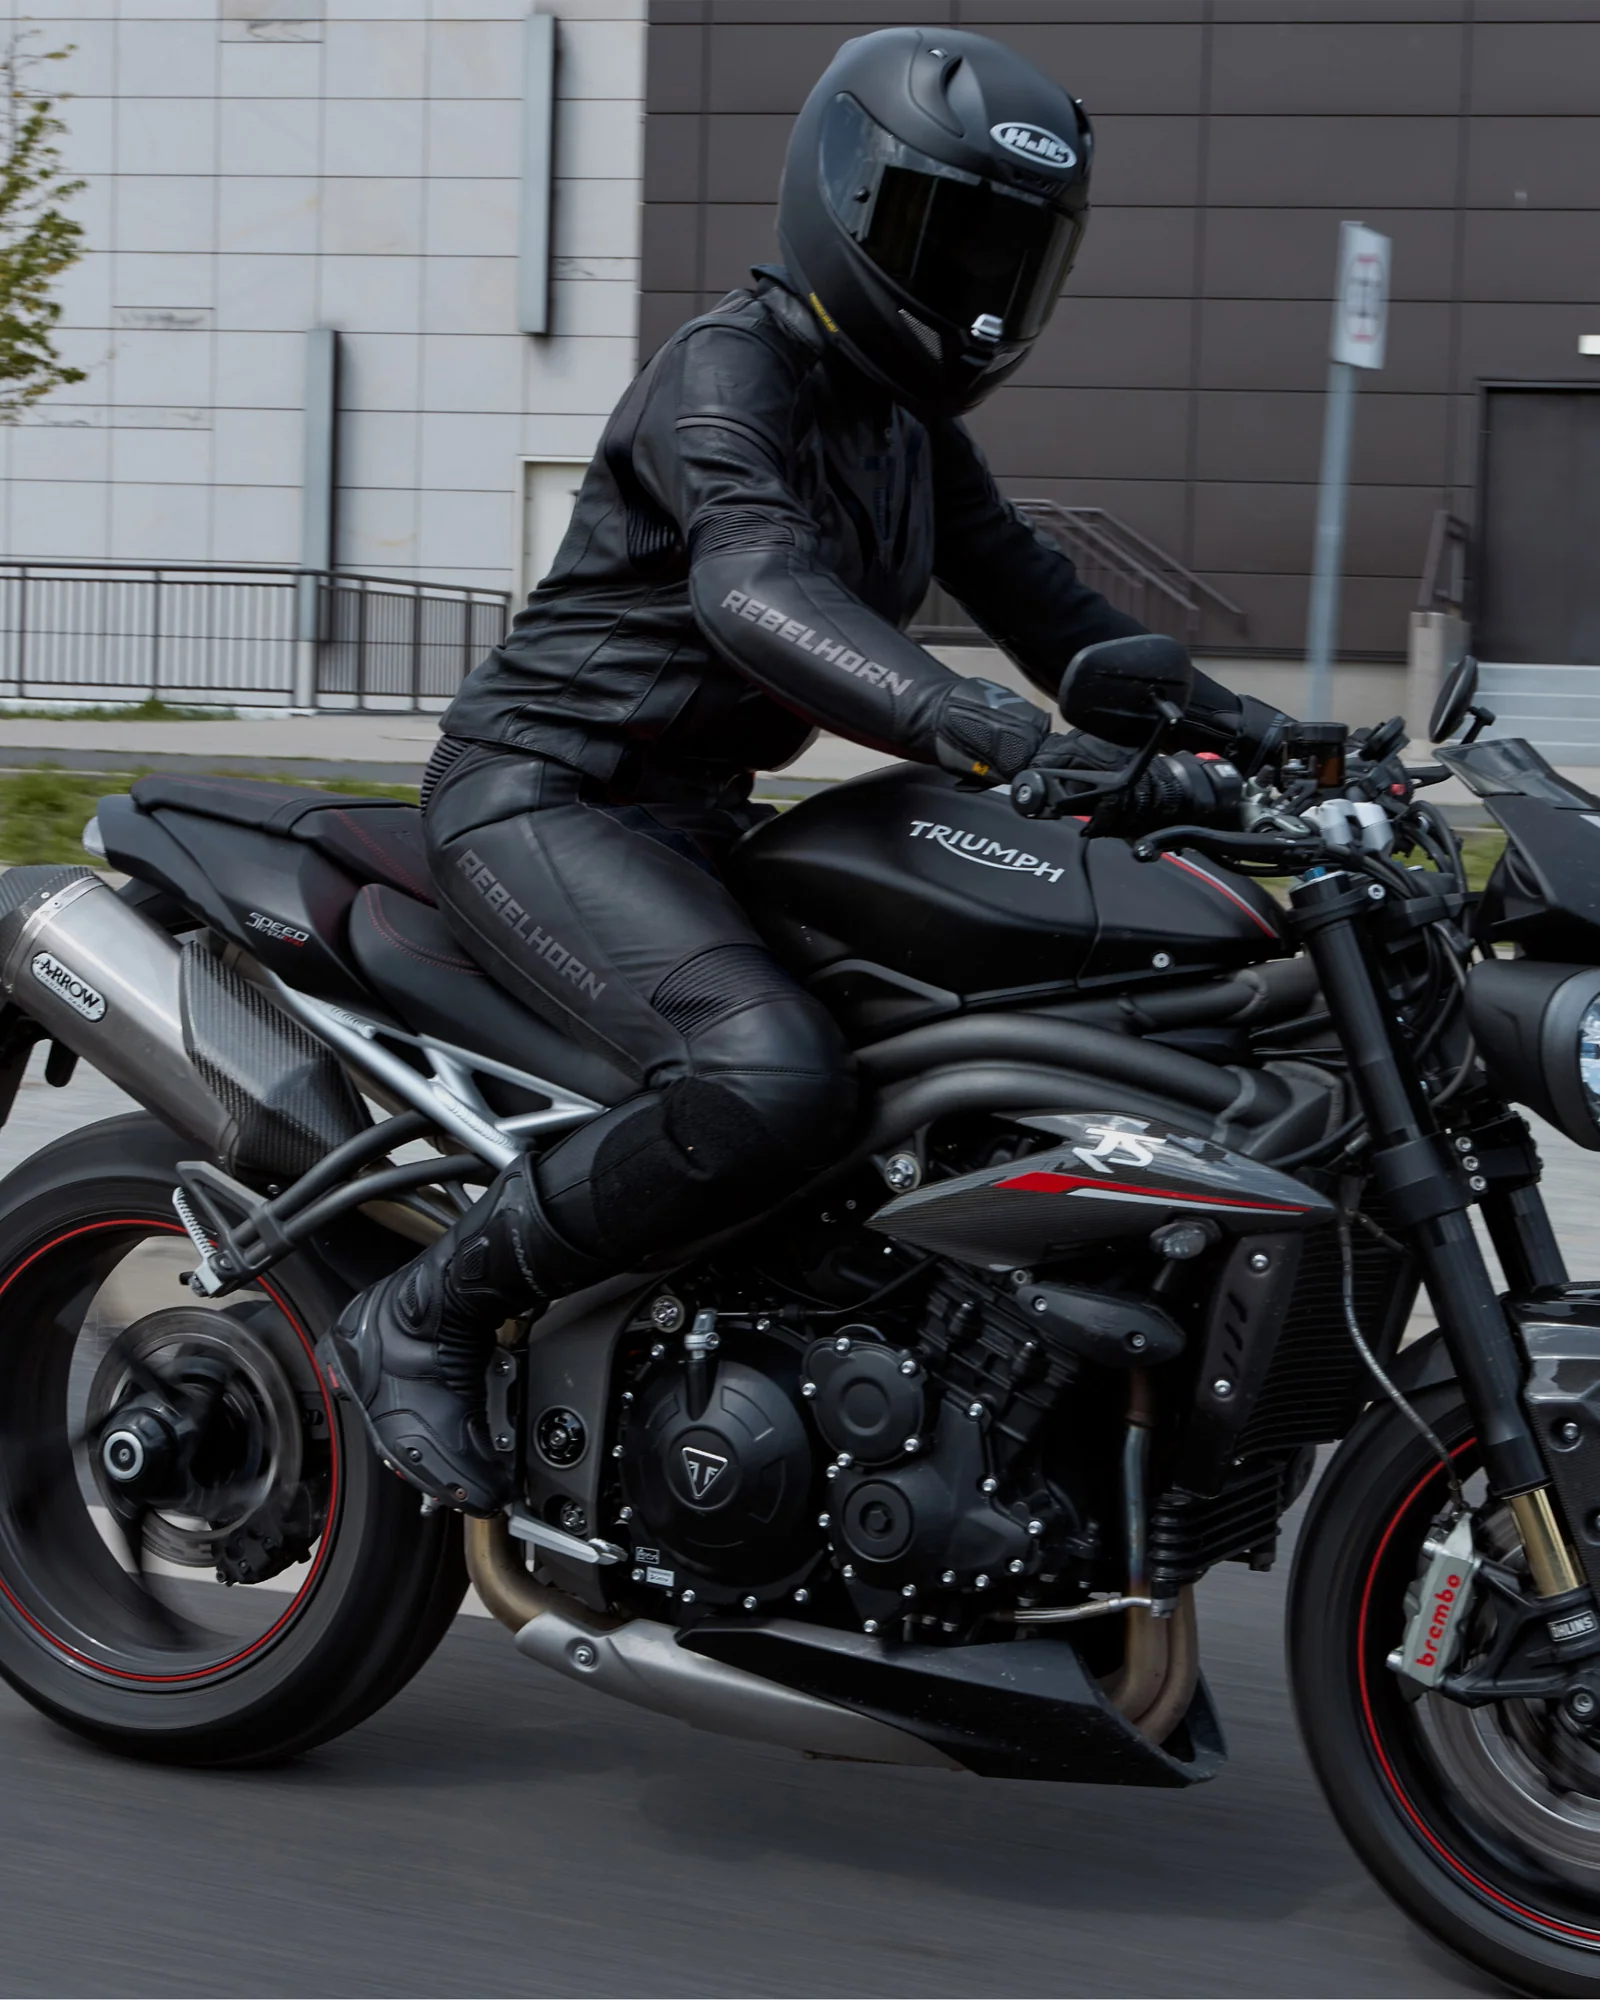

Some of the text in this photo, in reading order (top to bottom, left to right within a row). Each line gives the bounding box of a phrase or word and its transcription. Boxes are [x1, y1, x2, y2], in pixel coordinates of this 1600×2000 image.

[1002, 127, 1068, 162] HJC
[721, 590, 914, 696] REBELHORN
[909, 820, 1065, 883] TRIUMPH
[245, 912, 310, 942] SPEED
[456, 849, 607, 1000] REBELHORN
[40, 958, 100, 1008] ARROW
[1415, 1574, 1462, 1667] brembo
